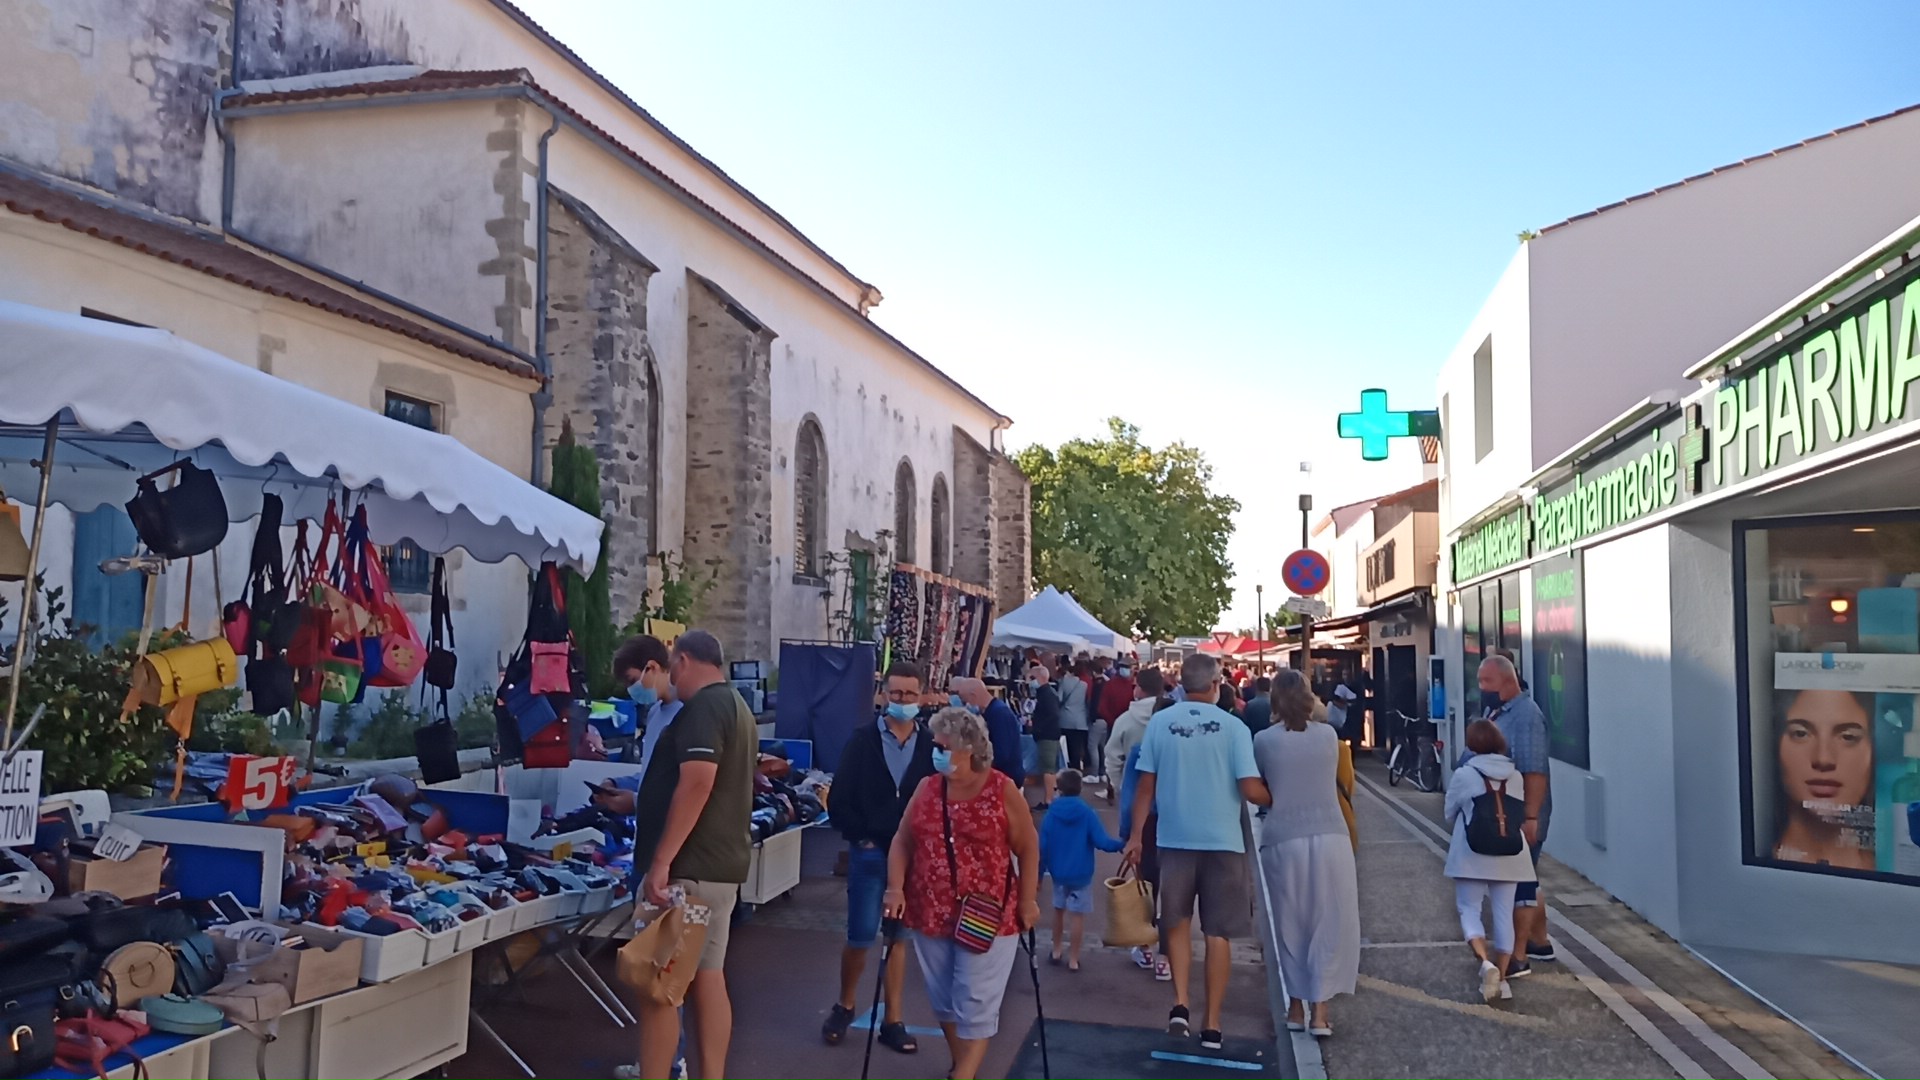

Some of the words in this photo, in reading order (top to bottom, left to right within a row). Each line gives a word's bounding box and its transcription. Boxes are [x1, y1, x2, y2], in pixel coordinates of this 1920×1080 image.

[1535, 428, 1678, 558] Parapharmacie
[1485, 507, 1522, 570] Médical
[242, 756, 296, 810] 5€
[100, 835, 131, 861] cuir
